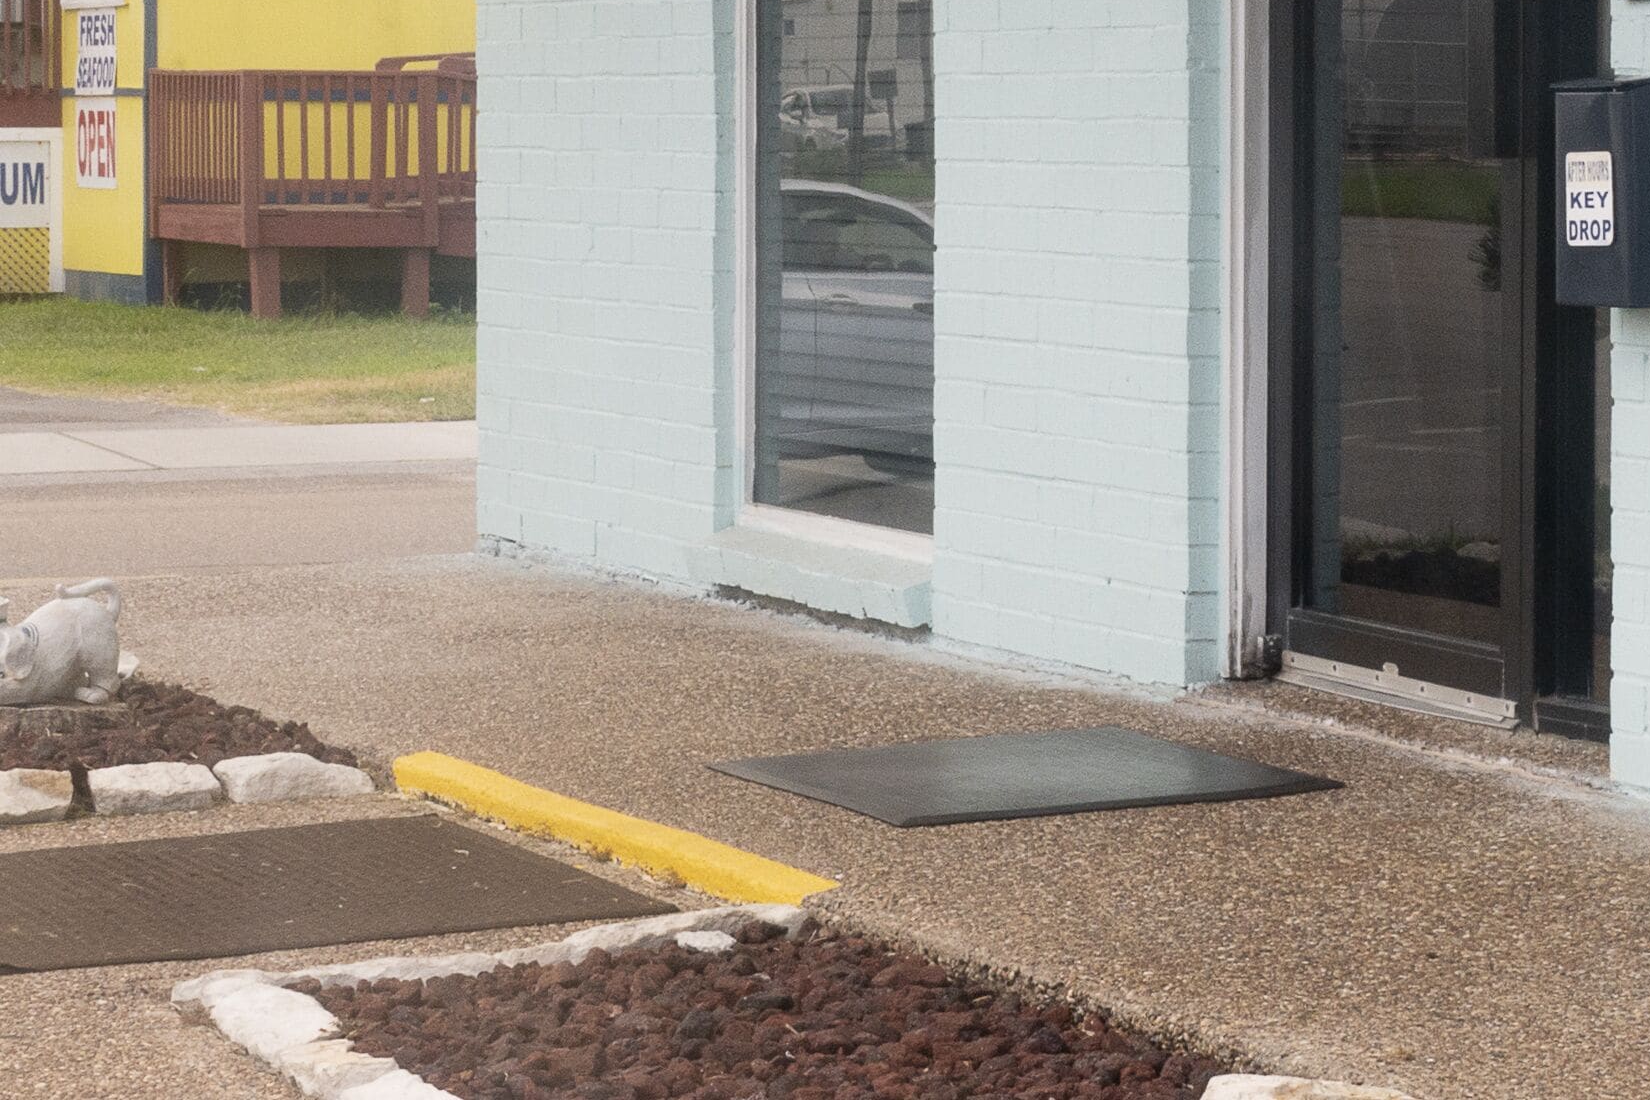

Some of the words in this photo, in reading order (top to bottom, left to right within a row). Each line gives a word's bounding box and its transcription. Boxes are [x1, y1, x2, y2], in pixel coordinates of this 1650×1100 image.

[80, 14, 115, 46] FRESH
[77, 56, 115, 89] SEAFOOD
[78, 109, 116, 178] OPEN
[0, 162, 45, 205] UM
[1570, 191, 1609, 209] KEY
[1569, 220, 1611, 241] DROP
